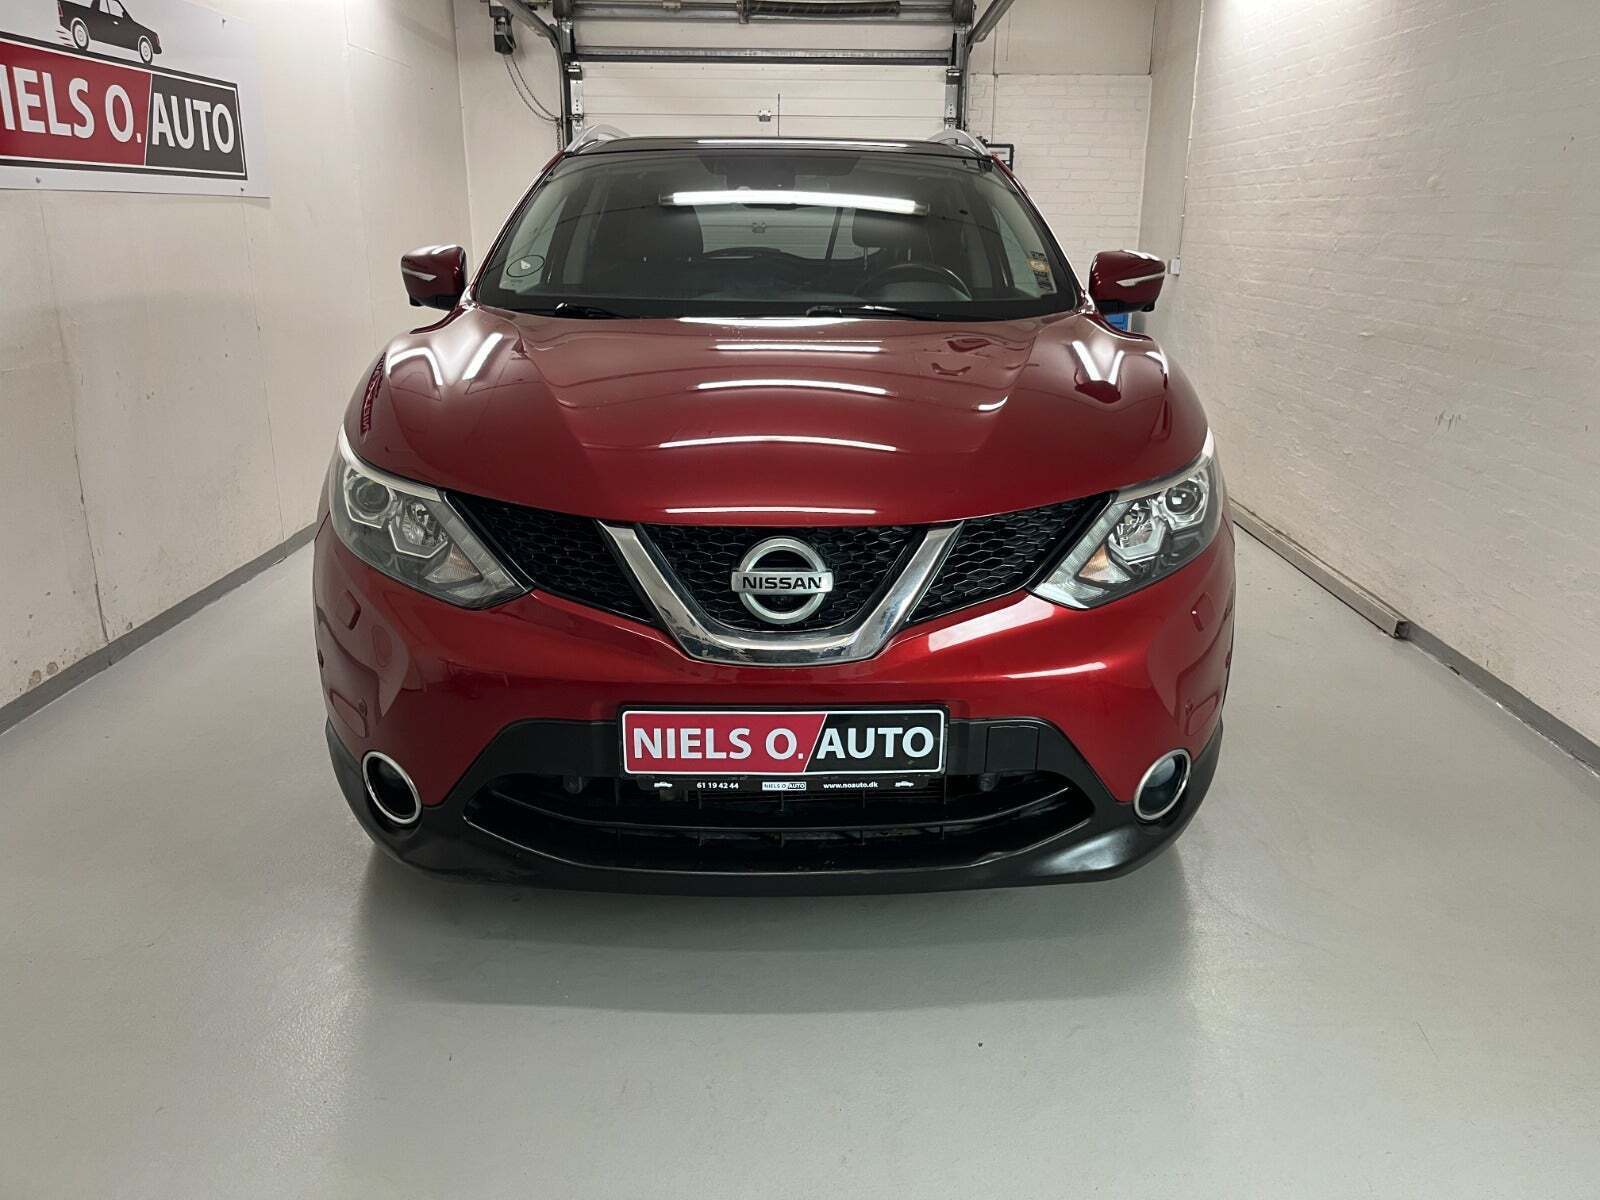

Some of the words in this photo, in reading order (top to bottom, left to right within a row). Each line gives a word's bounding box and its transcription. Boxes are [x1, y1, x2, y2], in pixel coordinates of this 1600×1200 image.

[0, 64, 95, 139] IELS
[105, 84, 143, 143] O.
[152, 92, 235, 154] AUTO
[743, 576, 822, 590] NISSAN
[633, 727, 752, 760] NIELS
[765, 727, 804, 760] O.
[816, 726, 934, 759] AUTO
[823, 781, 879, 789] www.noauto.dk
